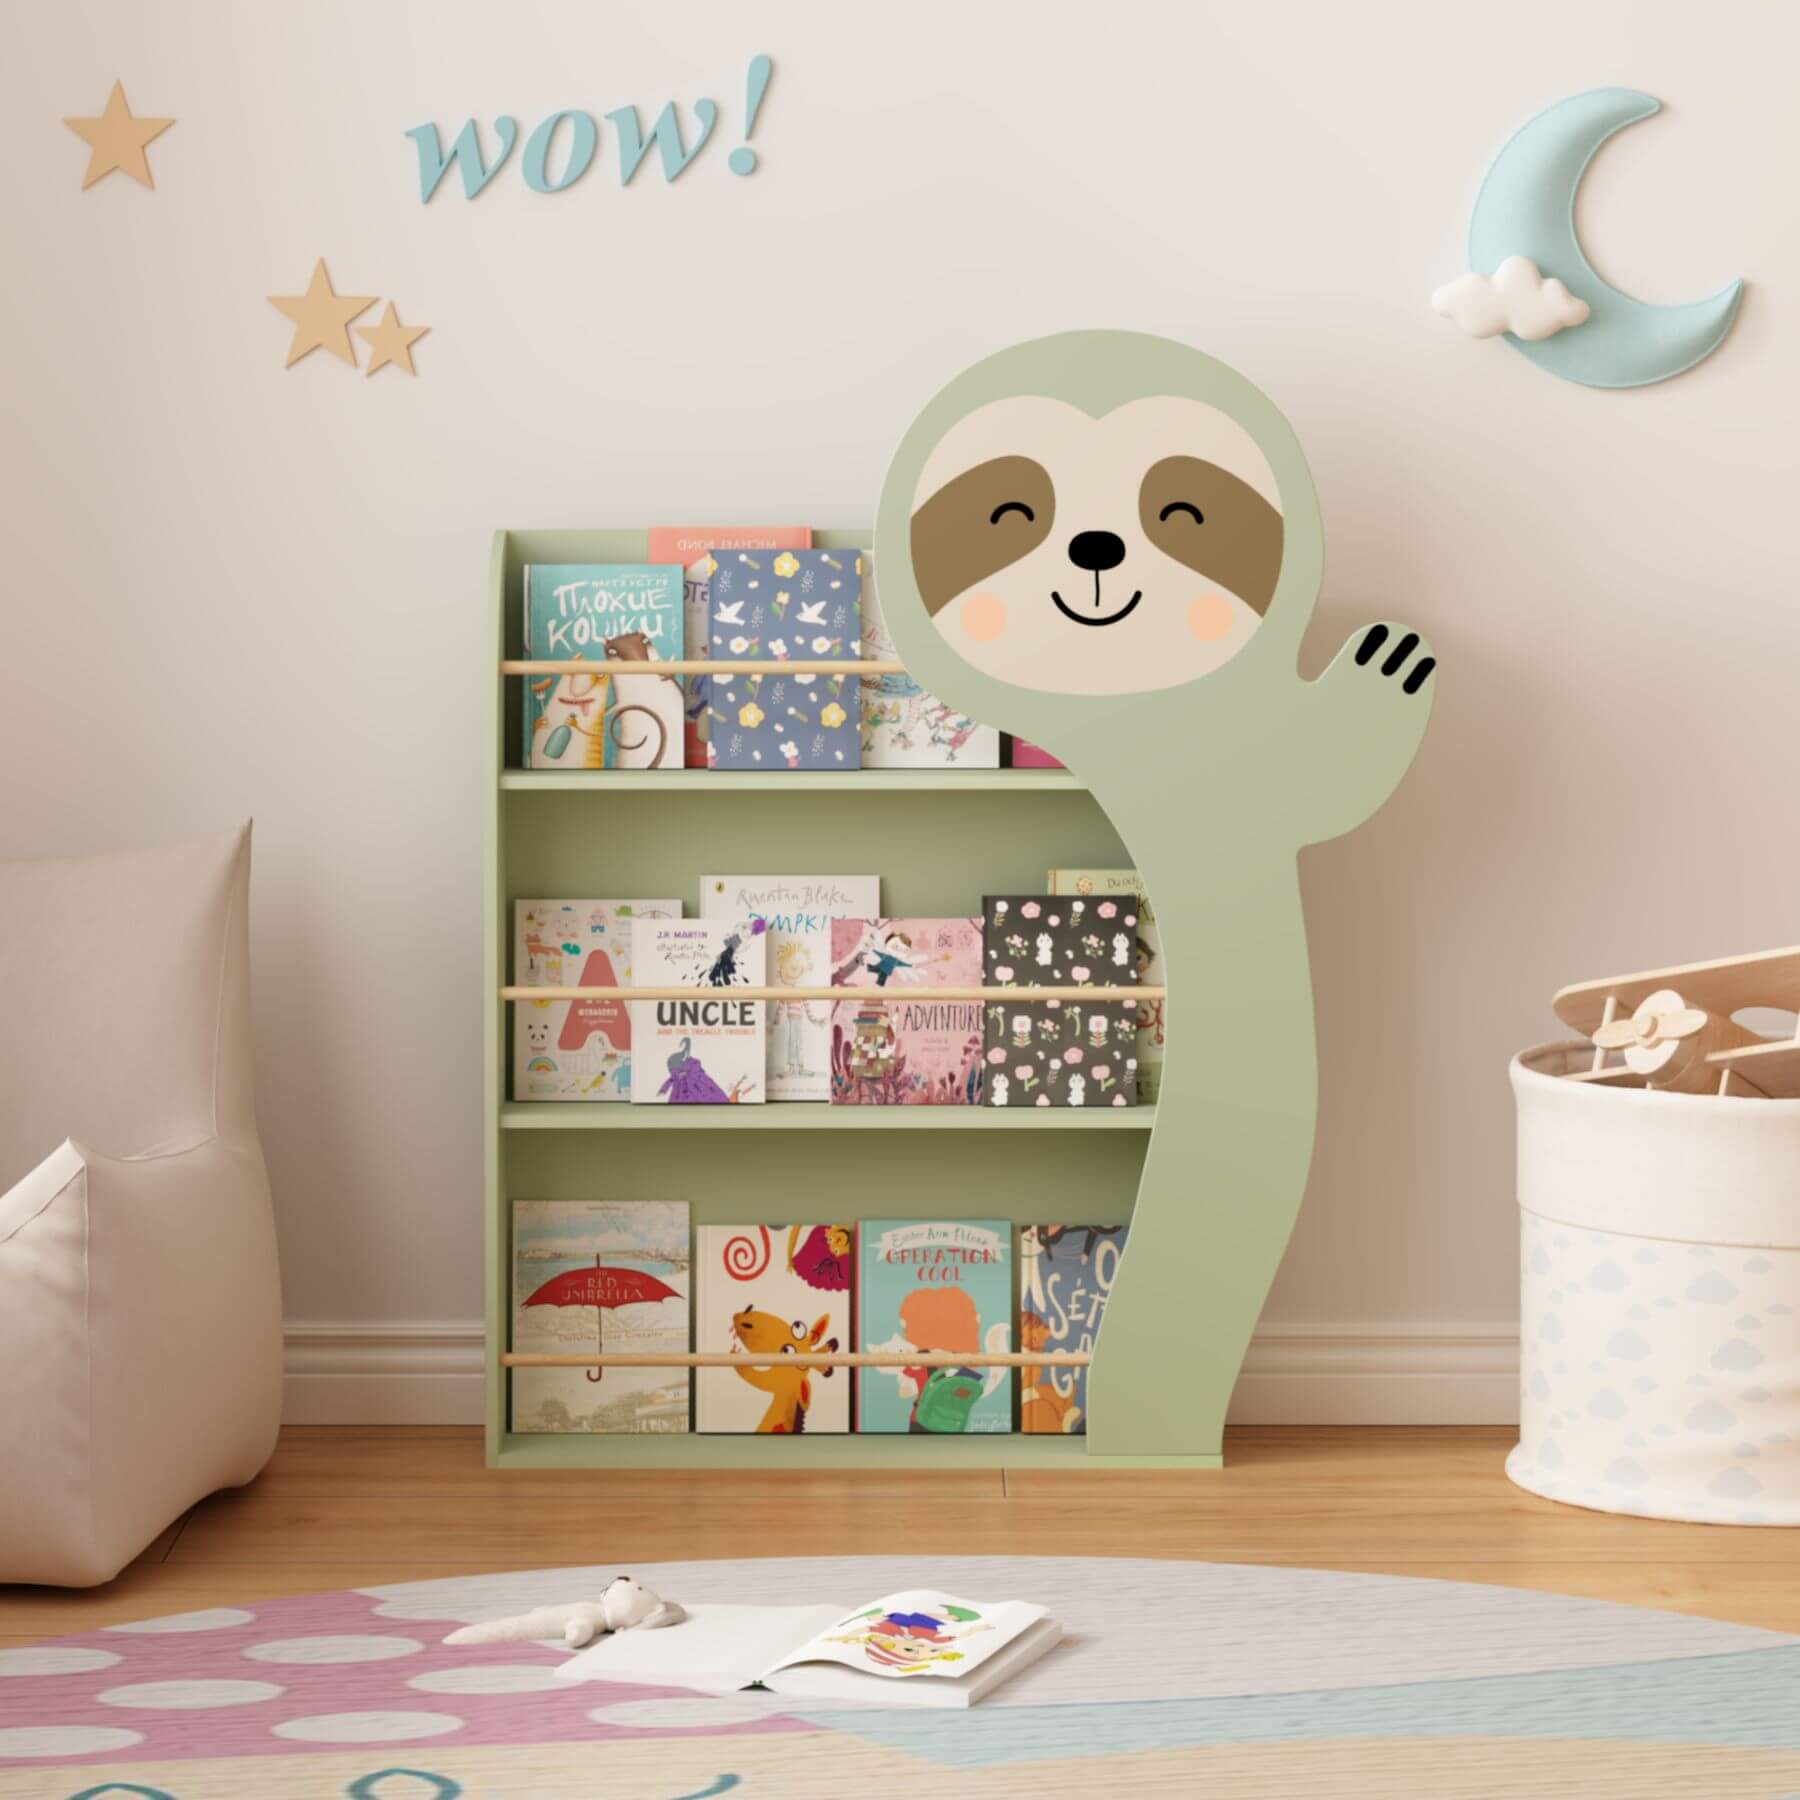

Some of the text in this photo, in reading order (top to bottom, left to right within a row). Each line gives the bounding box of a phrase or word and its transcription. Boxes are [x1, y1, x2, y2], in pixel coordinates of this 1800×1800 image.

[404, 54, 773, 205] wow!
[657, 1001, 756, 1026] UNCLE
[886, 1248, 997, 1264] OPERATION
[917, 1265, 967, 1281] COOL
[586, 1277, 617, 1288] RED
[561, 1287, 646, 1300] UMBRELLA
